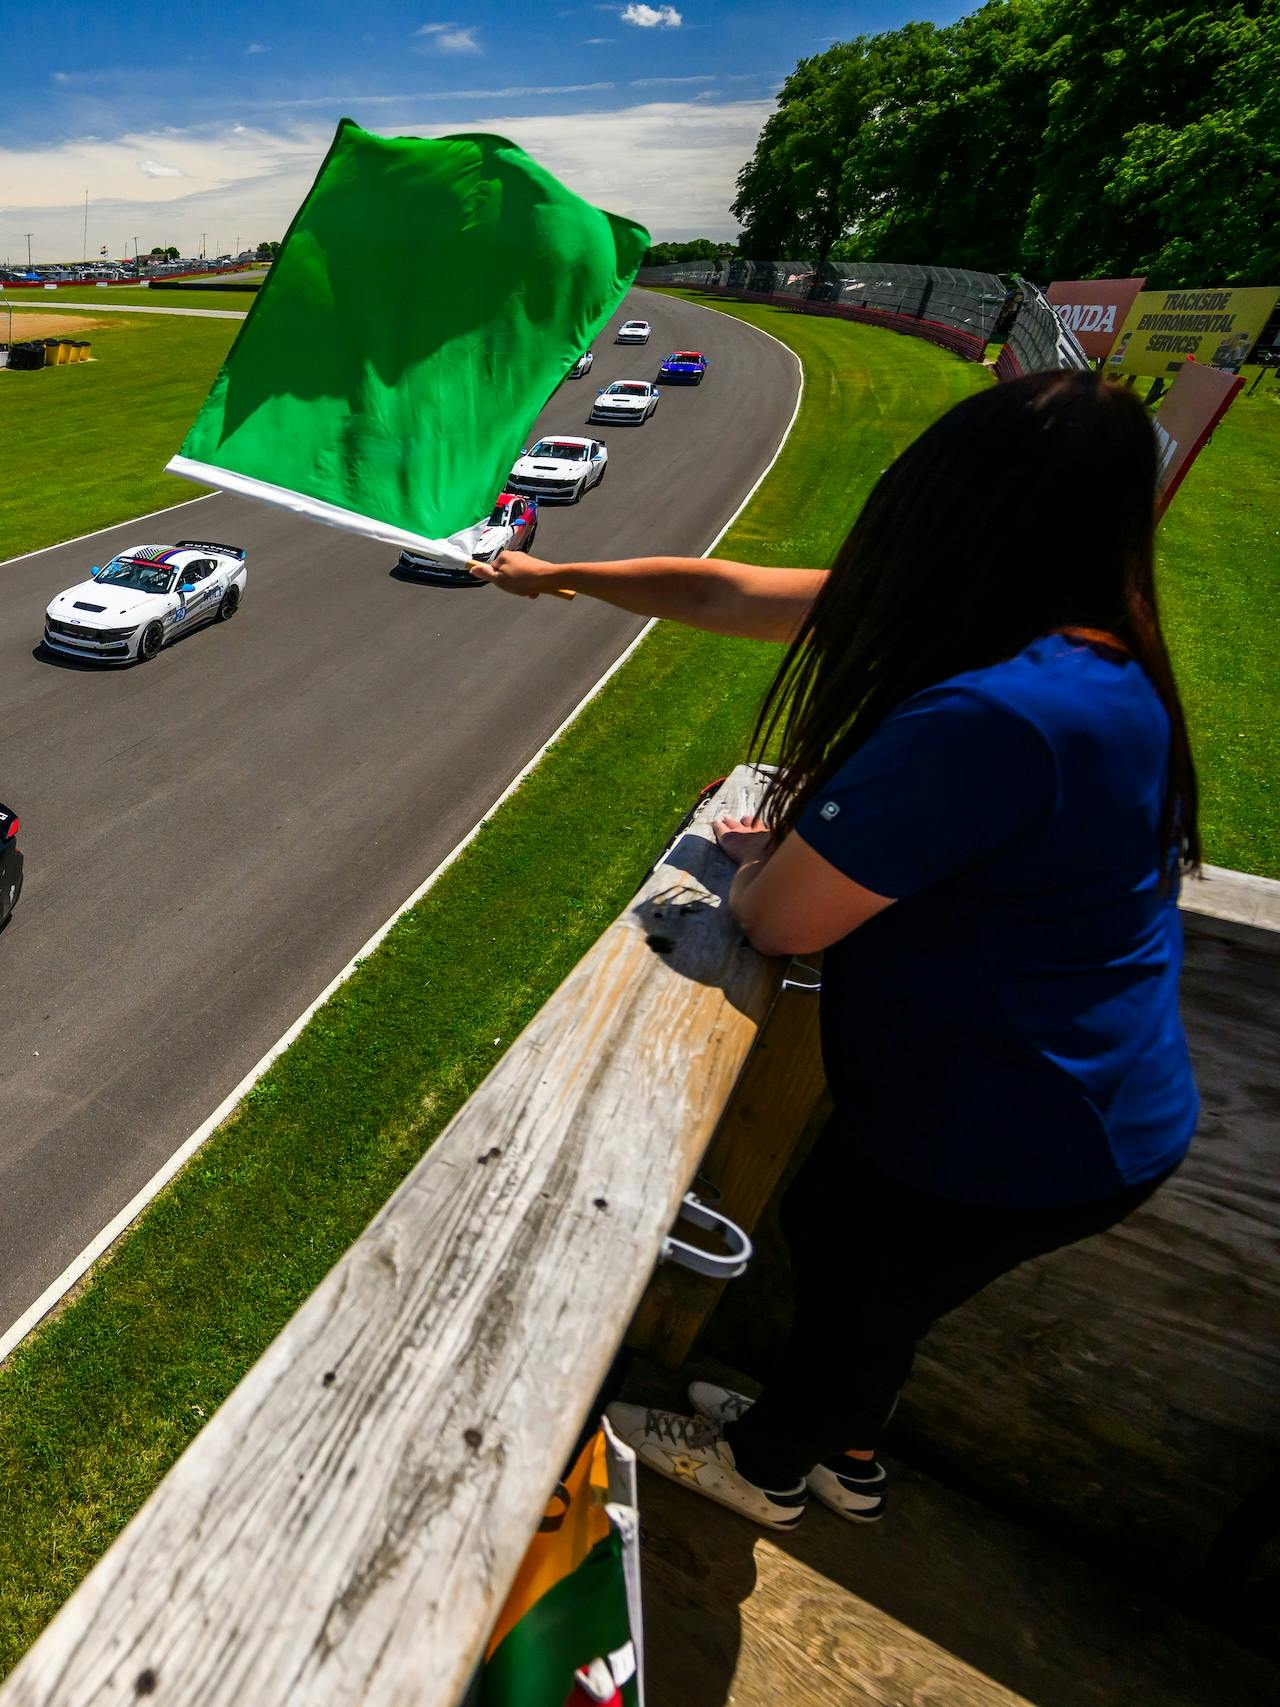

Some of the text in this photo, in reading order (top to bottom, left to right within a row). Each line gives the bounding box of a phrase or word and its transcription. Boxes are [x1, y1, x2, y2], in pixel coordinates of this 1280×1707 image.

[1162, 293, 1232, 310] TRACKSIDE
[1136, 314, 1236, 332] ENVIRONMENTAL
[1146, 334, 1203, 353] SERVICES
